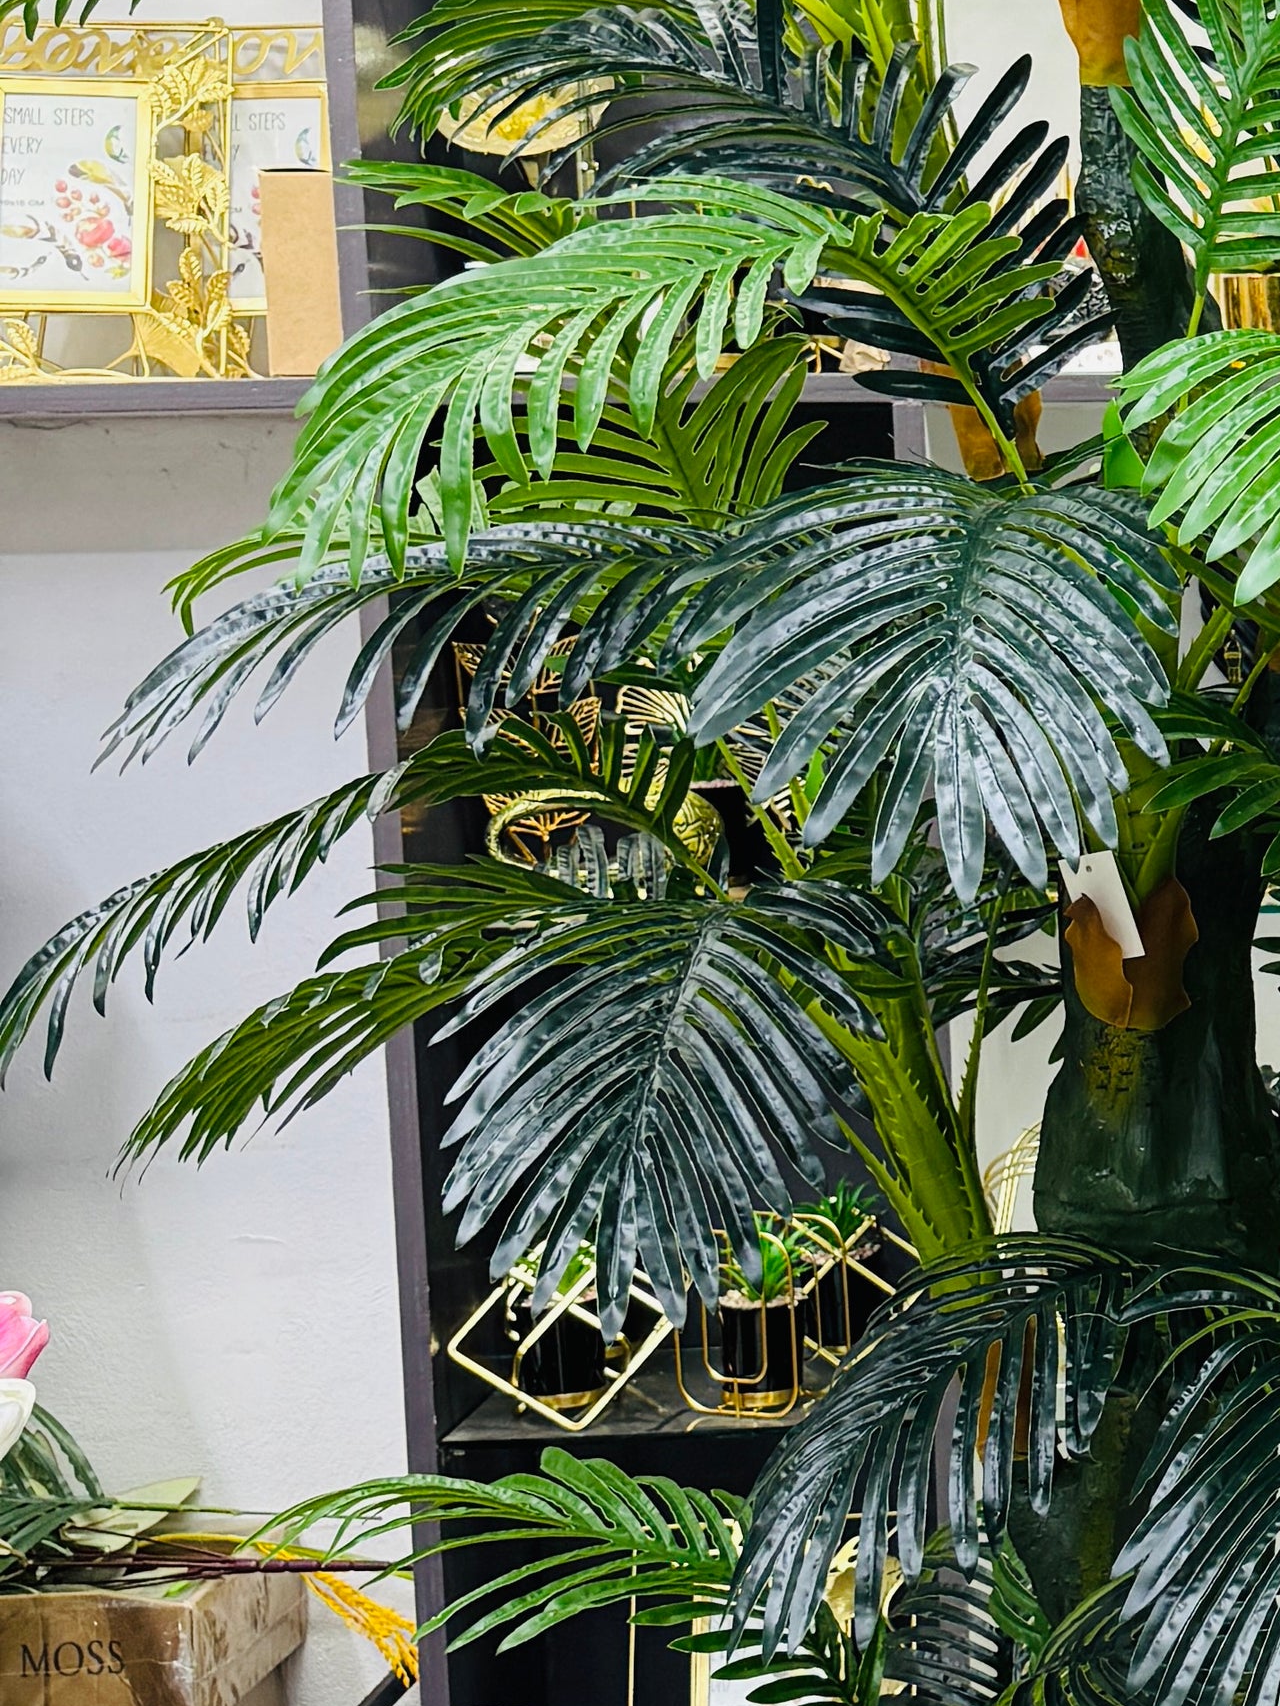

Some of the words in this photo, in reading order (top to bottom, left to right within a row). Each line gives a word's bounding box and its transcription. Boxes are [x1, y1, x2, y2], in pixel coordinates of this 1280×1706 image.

[4, 107, 44, 125] SMALL
[53, 108, 95, 126] STEPS
[249, 112, 286, 131] STEPS
[21, 1640, 125, 1677] MOSS
